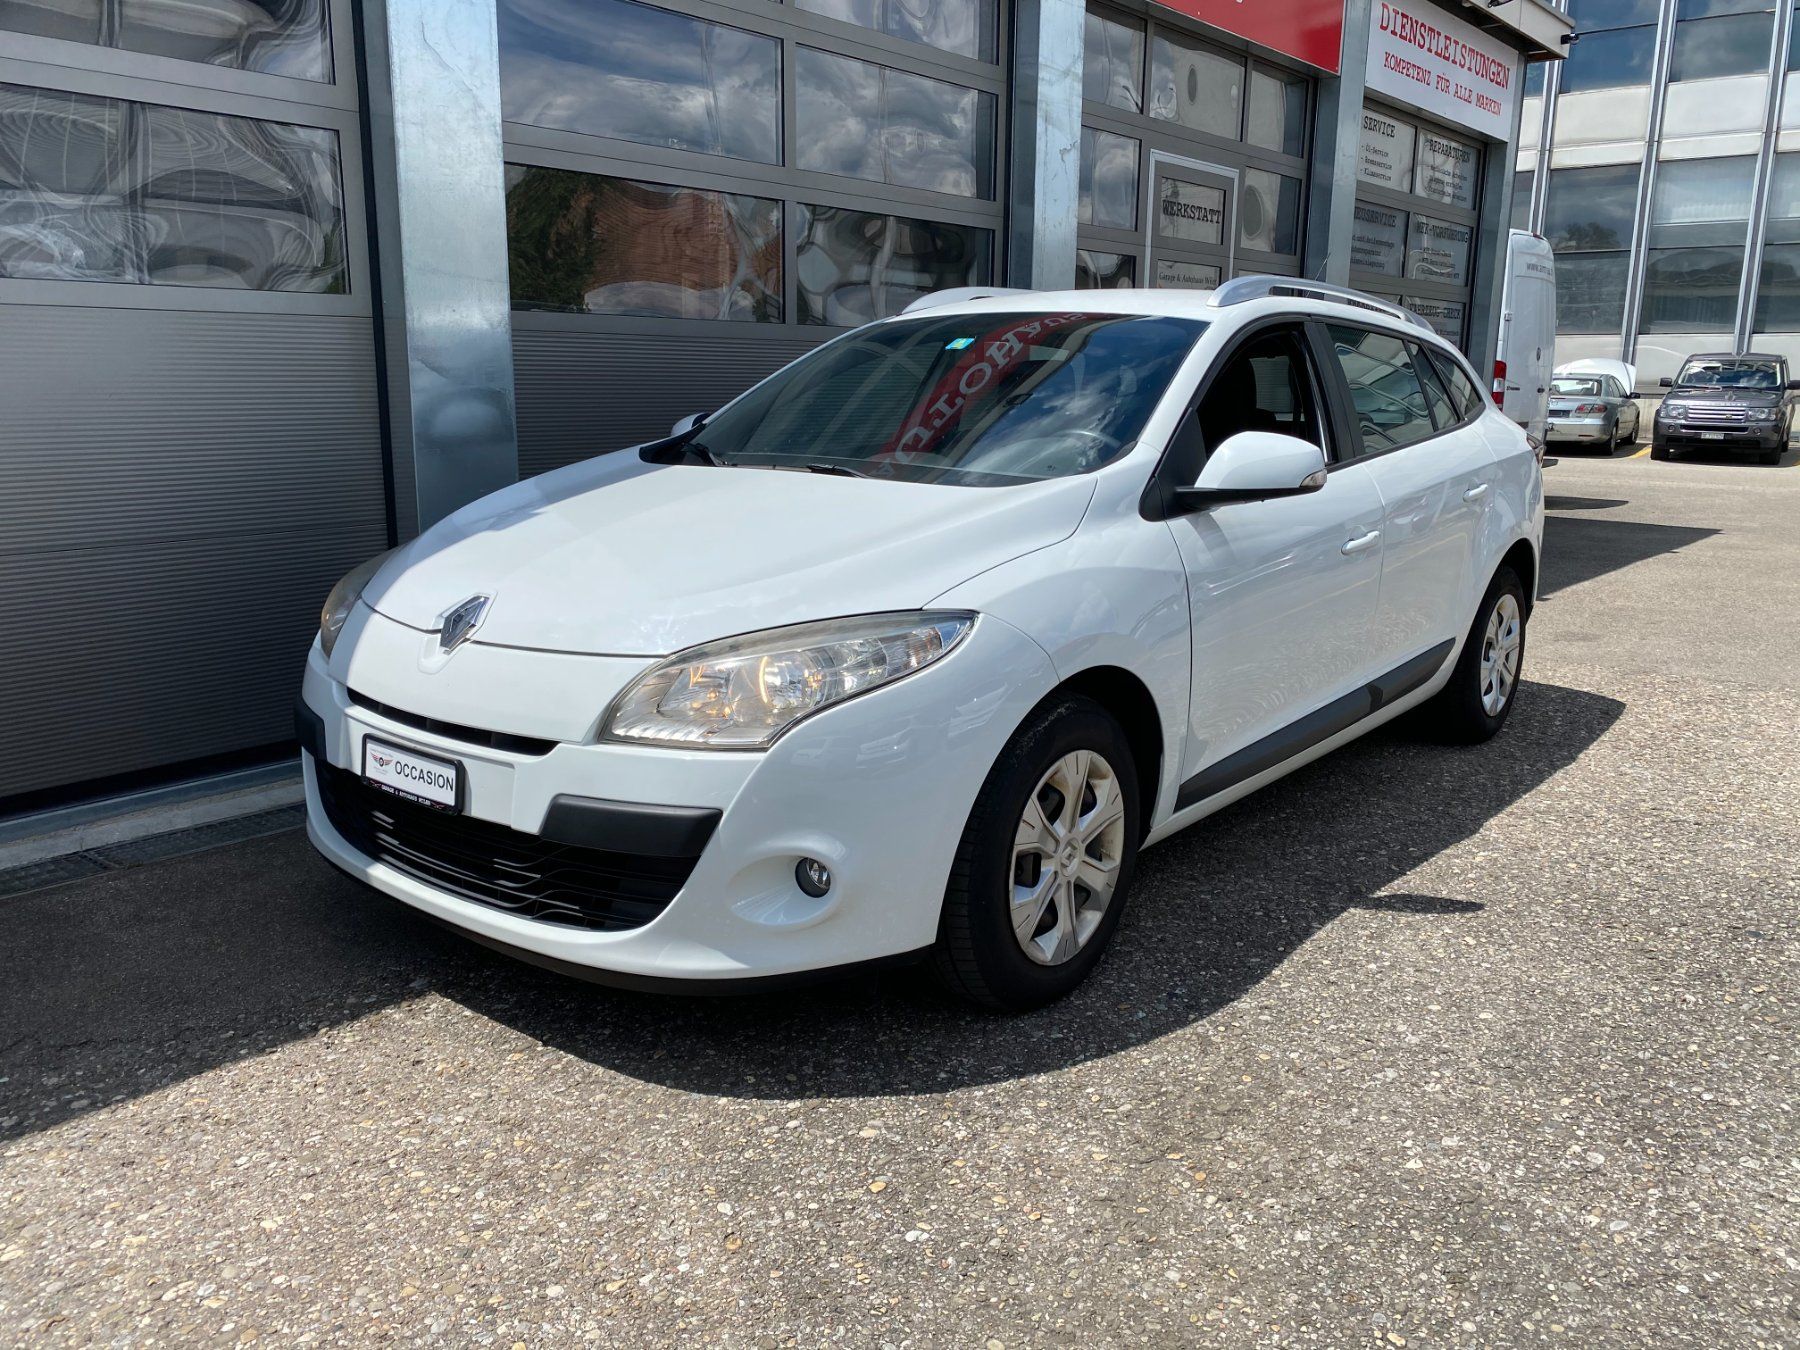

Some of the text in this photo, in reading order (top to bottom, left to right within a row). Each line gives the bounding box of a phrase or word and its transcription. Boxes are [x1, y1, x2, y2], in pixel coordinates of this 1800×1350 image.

[1379, 2, 1510, 90] DIENSTLEISTUNGEN
[1384, 51, 1502, 116] KOMPETENZ FÜR ALLE MARKEN
[1363, 115, 1396, 138] SERVICE
[1429, 139, 1471, 163] REPARATUREN
[1161, 199, 1222, 224] WERKSTATT
[394, 760, 454, 792] OCCASION
